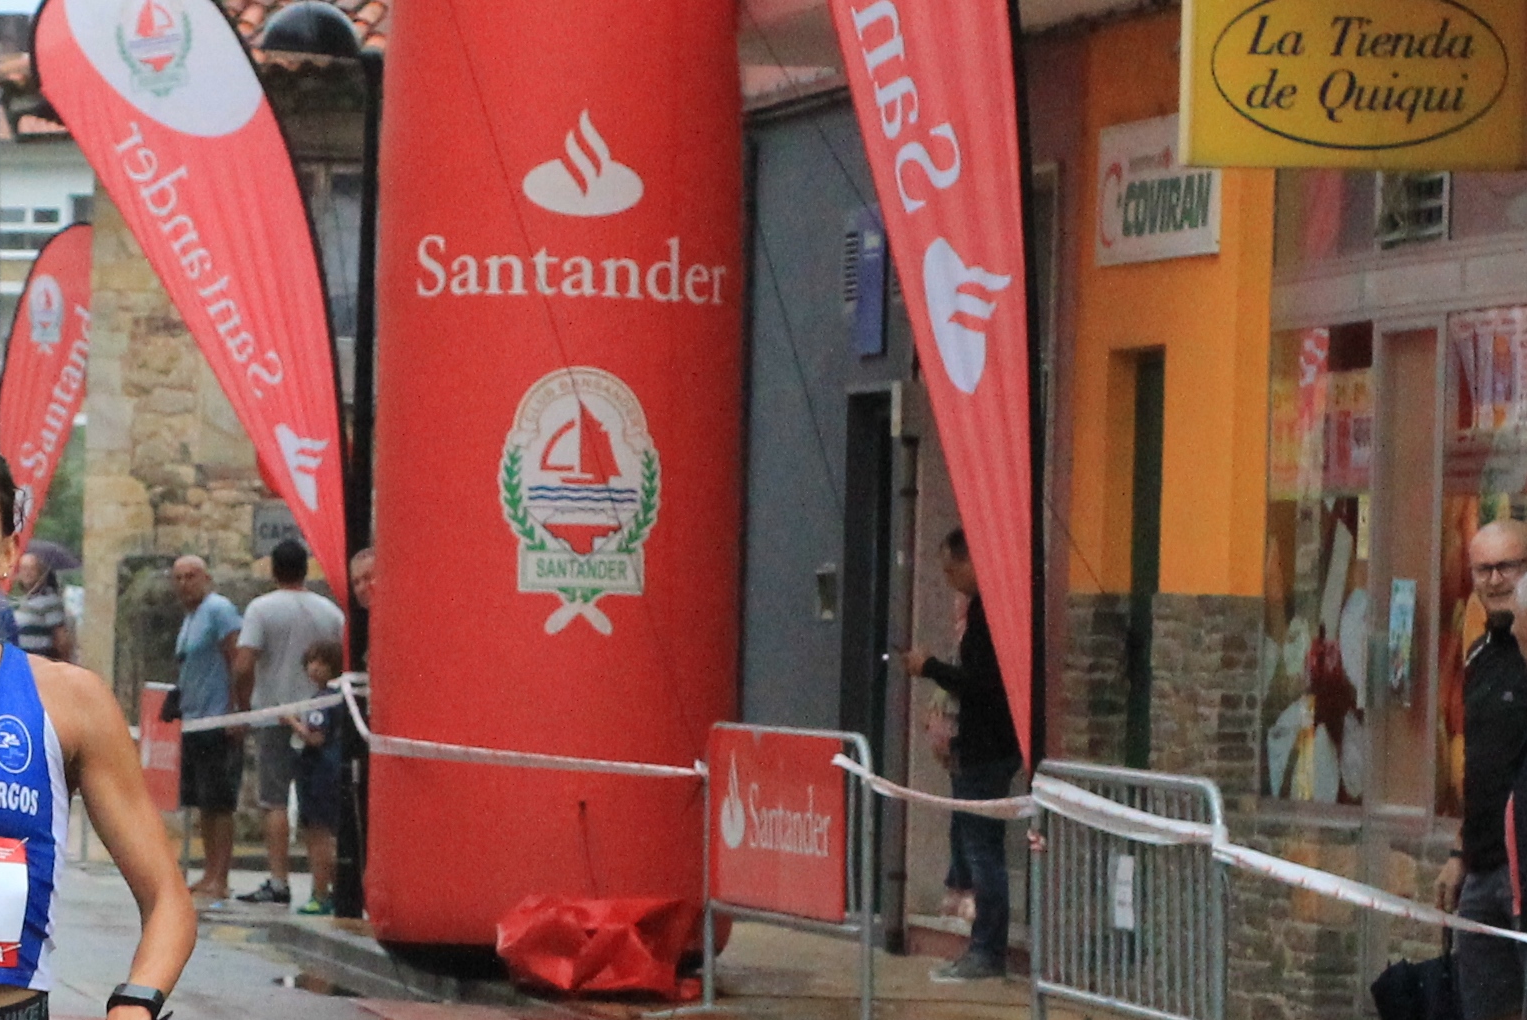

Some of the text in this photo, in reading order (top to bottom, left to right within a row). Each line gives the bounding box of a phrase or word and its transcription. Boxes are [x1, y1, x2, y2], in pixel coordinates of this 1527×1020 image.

[1247, 15, 1473, 59] La Tienda
[1246, 69, 1469, 124] de Quiqui
[416, 234, 726, 304] Santander
[536, 557, 628, 580] SANTANDER
[749, 782, 832, 857] Santander
